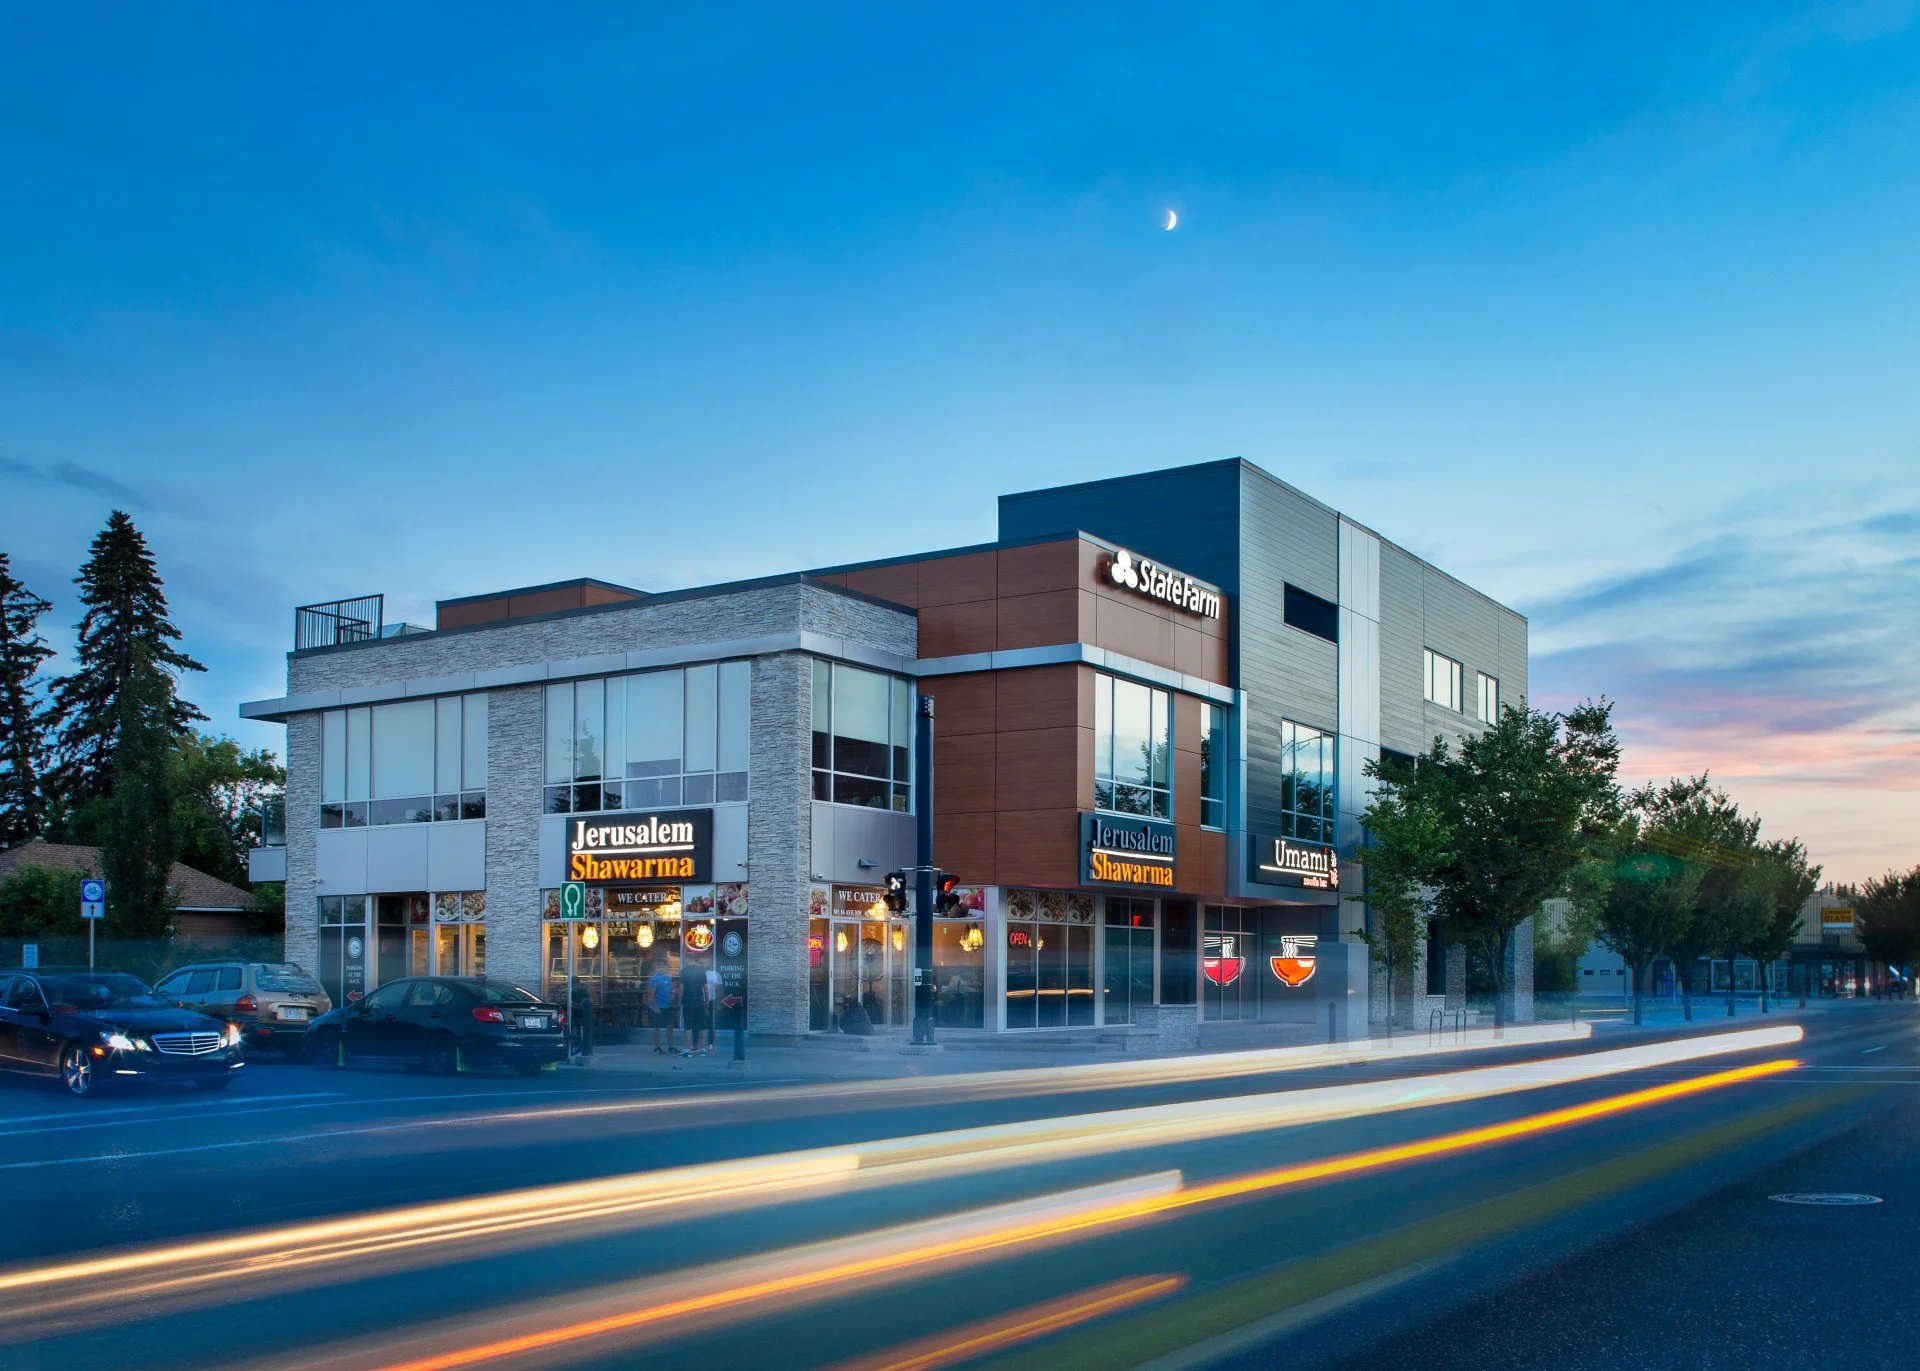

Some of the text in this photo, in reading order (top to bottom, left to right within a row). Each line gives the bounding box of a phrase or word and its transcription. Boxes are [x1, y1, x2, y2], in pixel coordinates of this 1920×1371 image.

[572, 817, 694, 850] Jerusalem
[1092, 819, 1173, 853] Jerusalem
[571, 854, 695, 880] Shawarma
[1090, 852, 1173, 886] Shawarma
[1275, 840, 1328, 871] Umami
[617, 892, 667, 904] WE CATER
[838, 890, 881, 903] WE CATER
[1010, 932, 1028, 944] OPEN
